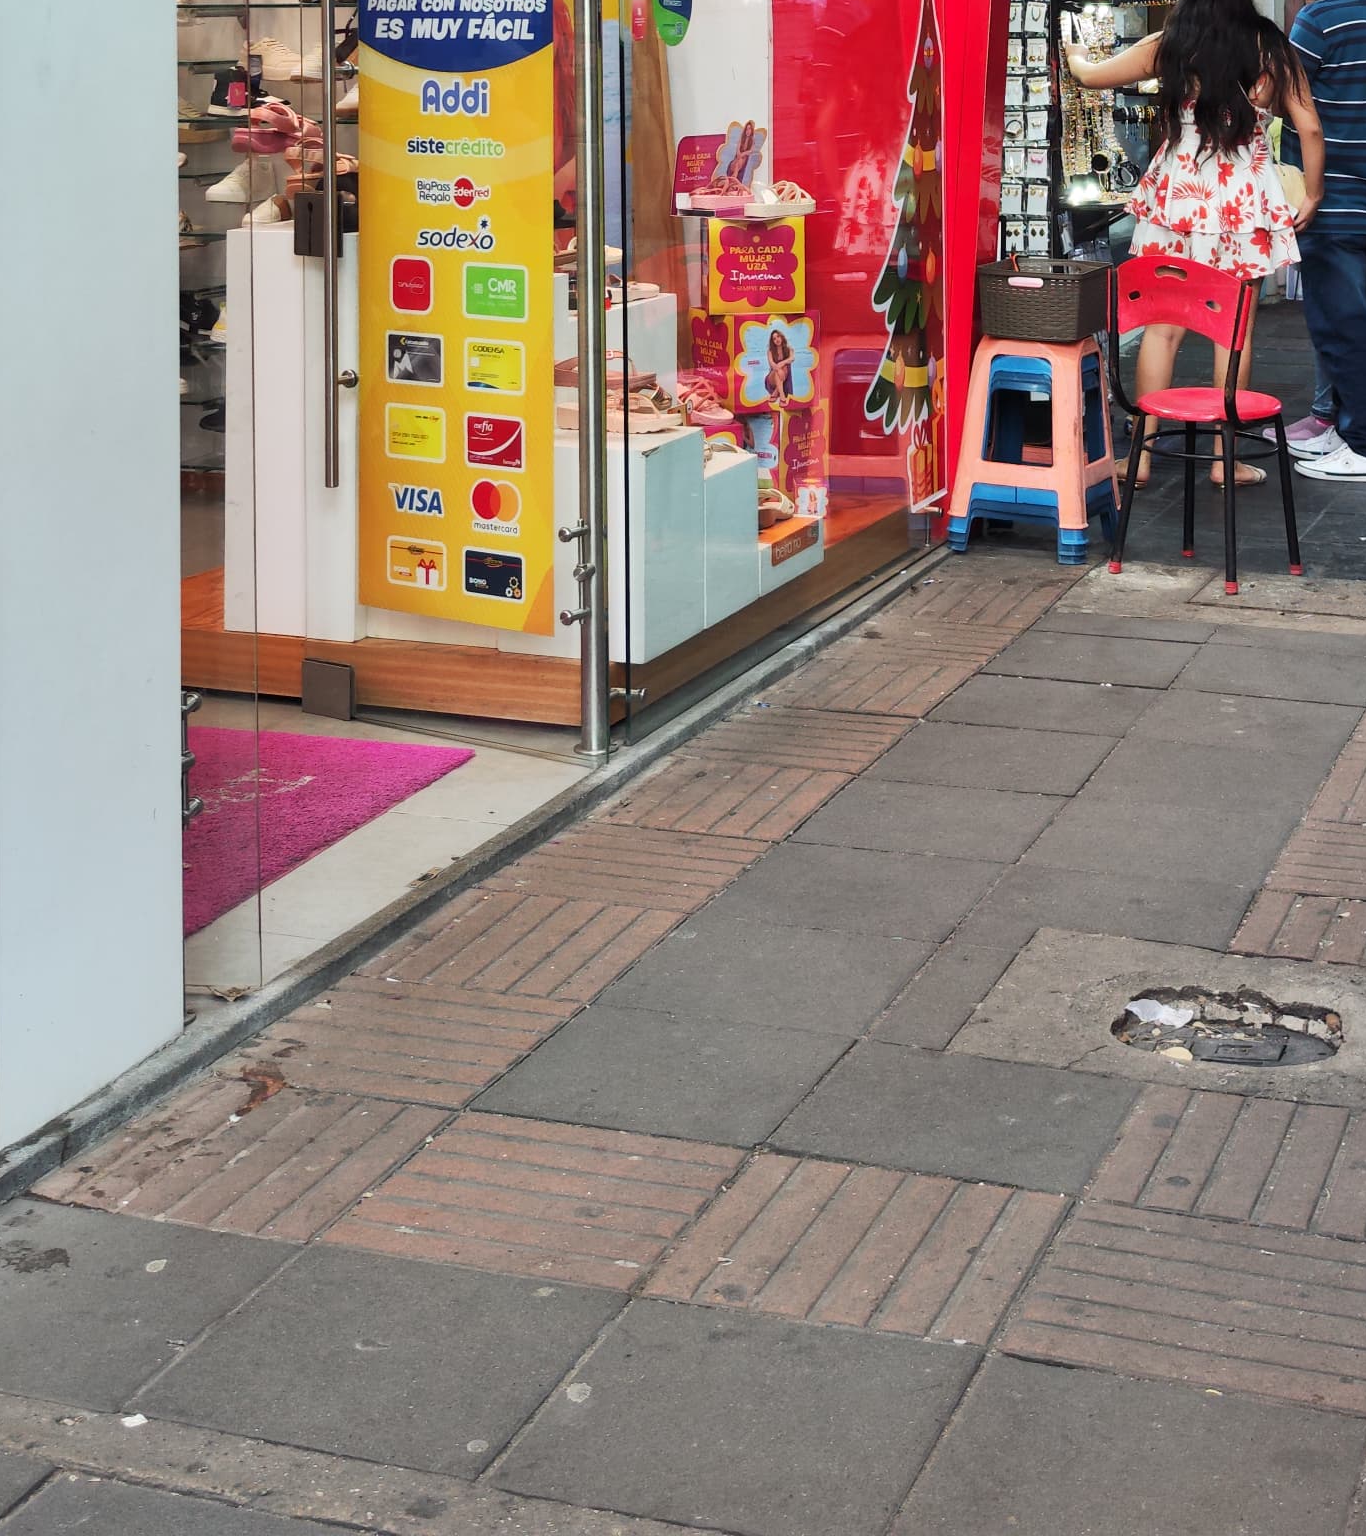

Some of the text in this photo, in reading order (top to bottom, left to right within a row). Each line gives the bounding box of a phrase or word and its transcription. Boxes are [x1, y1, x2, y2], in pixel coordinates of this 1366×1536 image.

[375, 13, 535, 41] ES MUY FÁCIL
[422, 80, 489, 114] Addi
[407, 137, 503, 156] sistecrédito
[419, 191, 451, 203] Regalo
[454, 186, 489, 197] Edenred
[418, 227, 493, 249] sodexo
[757, 245, 784, 253] CADA
[488, 278, 517, 294] CMR
[394, 486, 443, 515] VISA
[473, 522, 518, 534] mastercard
